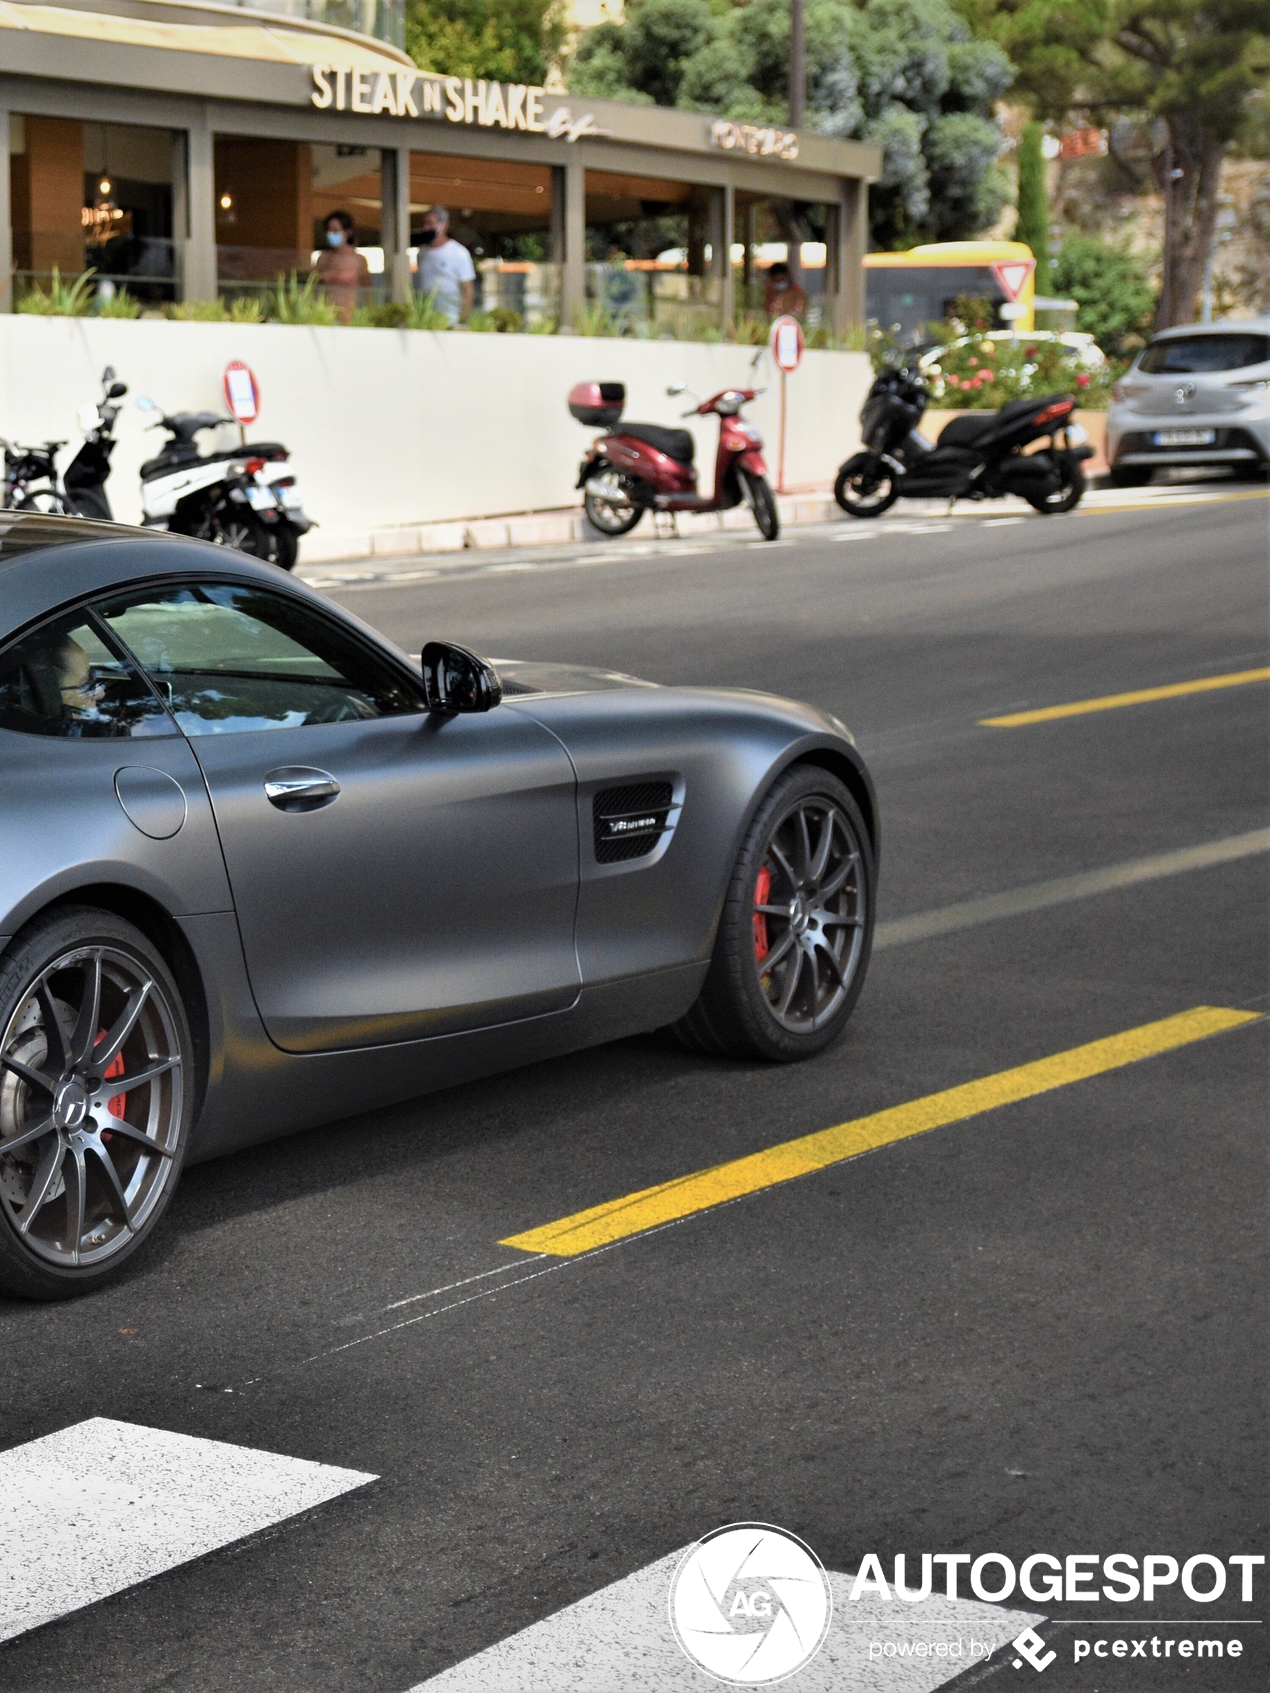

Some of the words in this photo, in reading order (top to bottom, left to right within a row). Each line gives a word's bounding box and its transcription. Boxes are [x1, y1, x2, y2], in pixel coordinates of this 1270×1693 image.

[310, 63, 419, 117] STEAK
[423, 80, 441, 112] N
[444, 76, 546, 132] SHAKE
